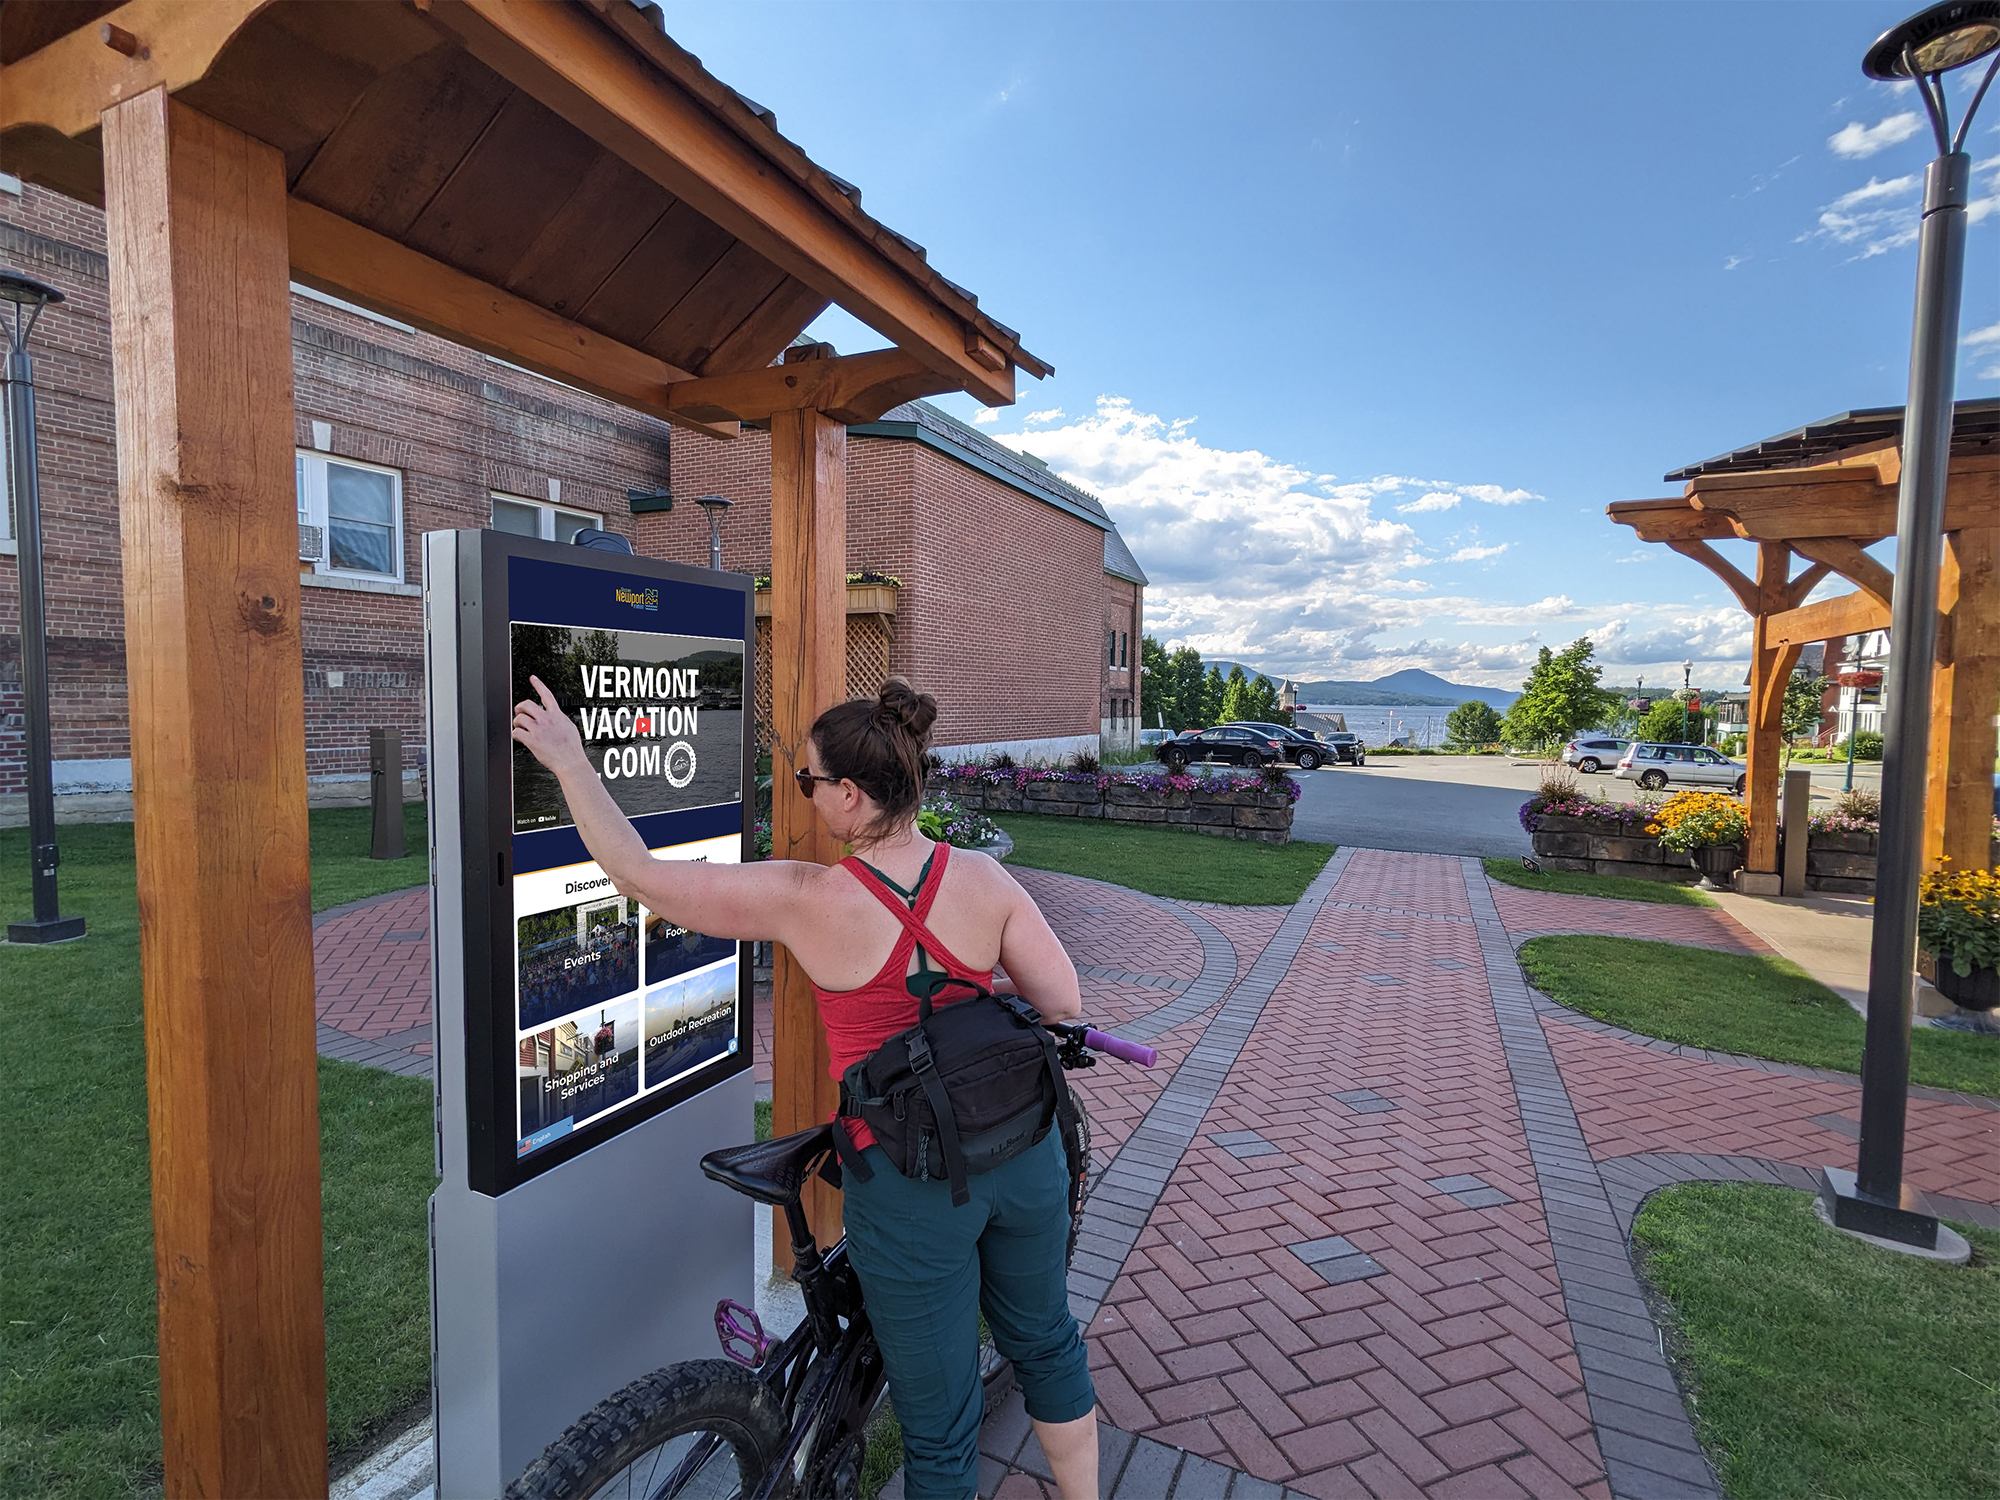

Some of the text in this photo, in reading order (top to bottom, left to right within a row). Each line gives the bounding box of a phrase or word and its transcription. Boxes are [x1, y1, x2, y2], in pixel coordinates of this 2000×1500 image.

[615, 589, 644, 607] Newport
[580, 665, 699, 698] VERMONT
[580, 706, 698, 740] VACATION
[565, 877, 611, 894] Discover
[564, 951, 601, 970] Events
[650, 1006, 732, 1047] Outdoor Recreation
[544, 1062, 597, 1093] Shopping
[599, 1052, 619, 1069] and
[561, 1073, 605, 1100] Services
[532, 1132, 551, 1145] English
